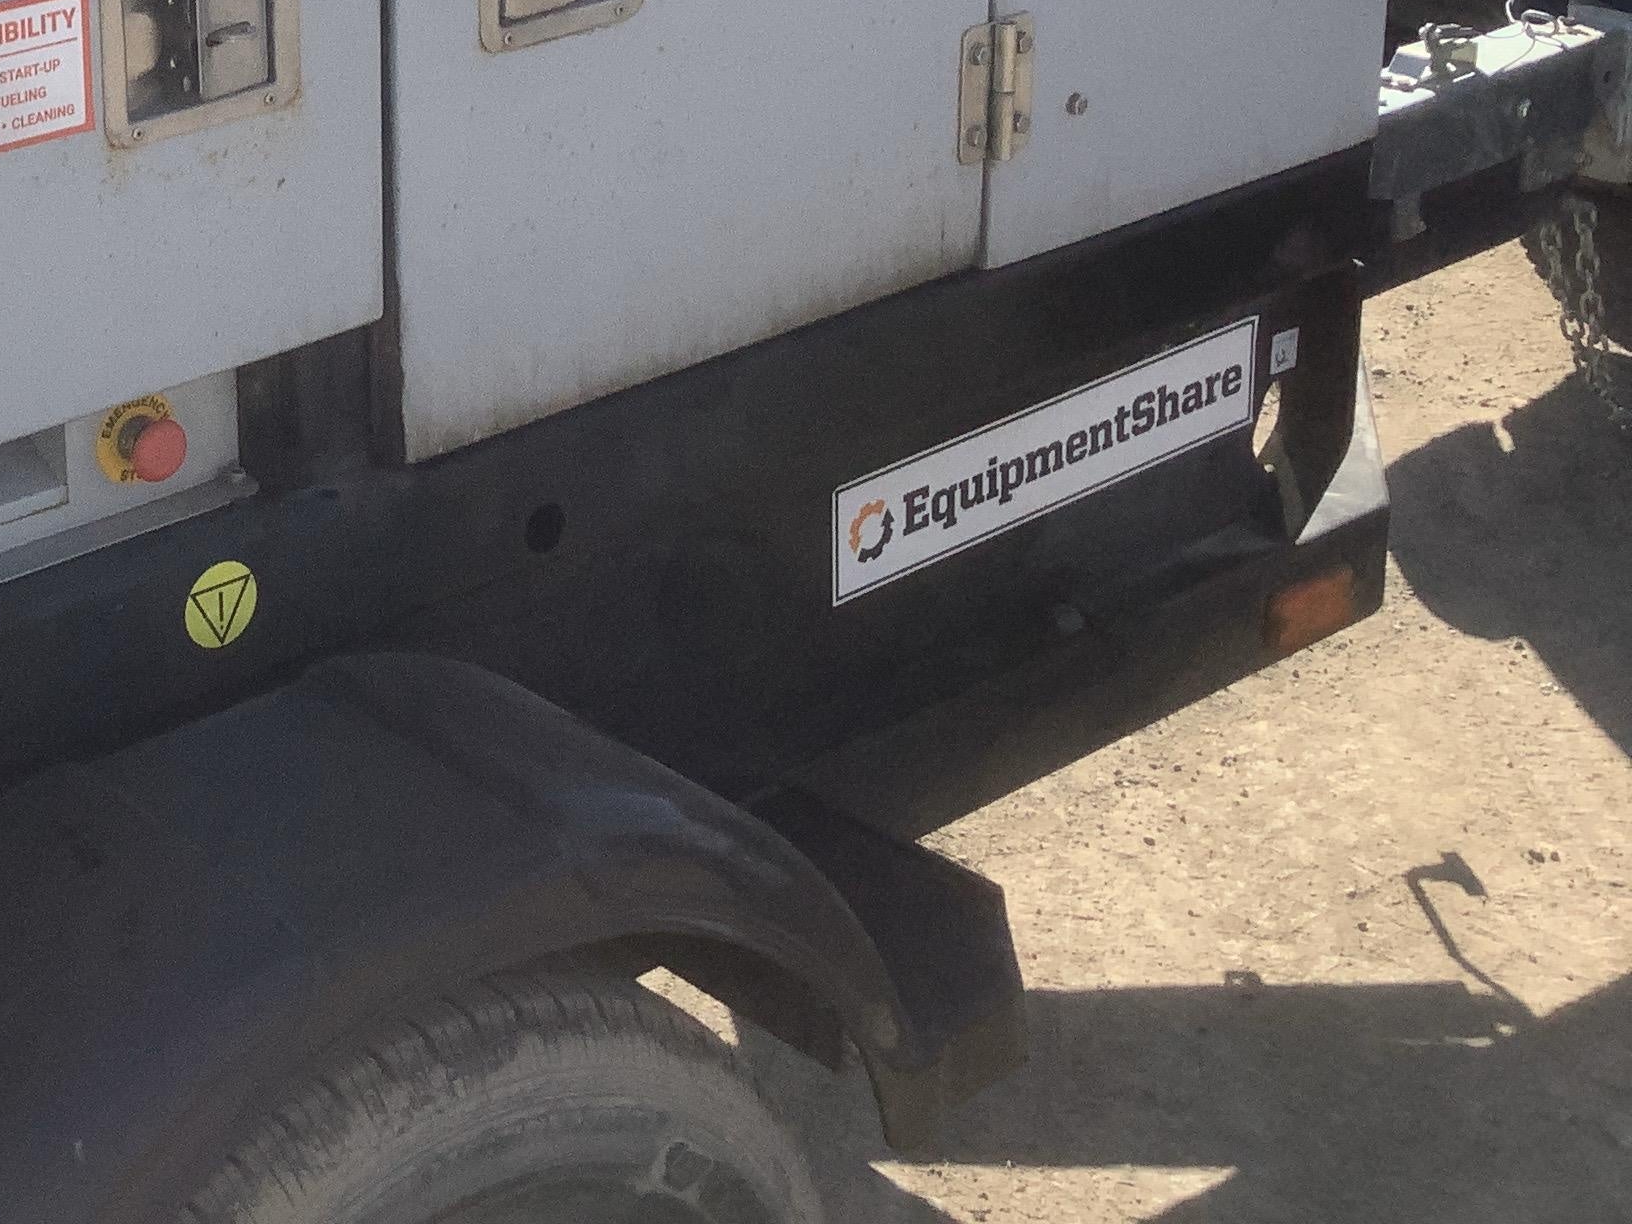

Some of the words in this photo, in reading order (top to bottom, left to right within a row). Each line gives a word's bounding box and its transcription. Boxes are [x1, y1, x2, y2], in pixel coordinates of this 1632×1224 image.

[0, 58, 61, 84] START-UP
[11, 103, 75, 130] CLEANING
[903, 363, 1242, 537] EquipmentShare
